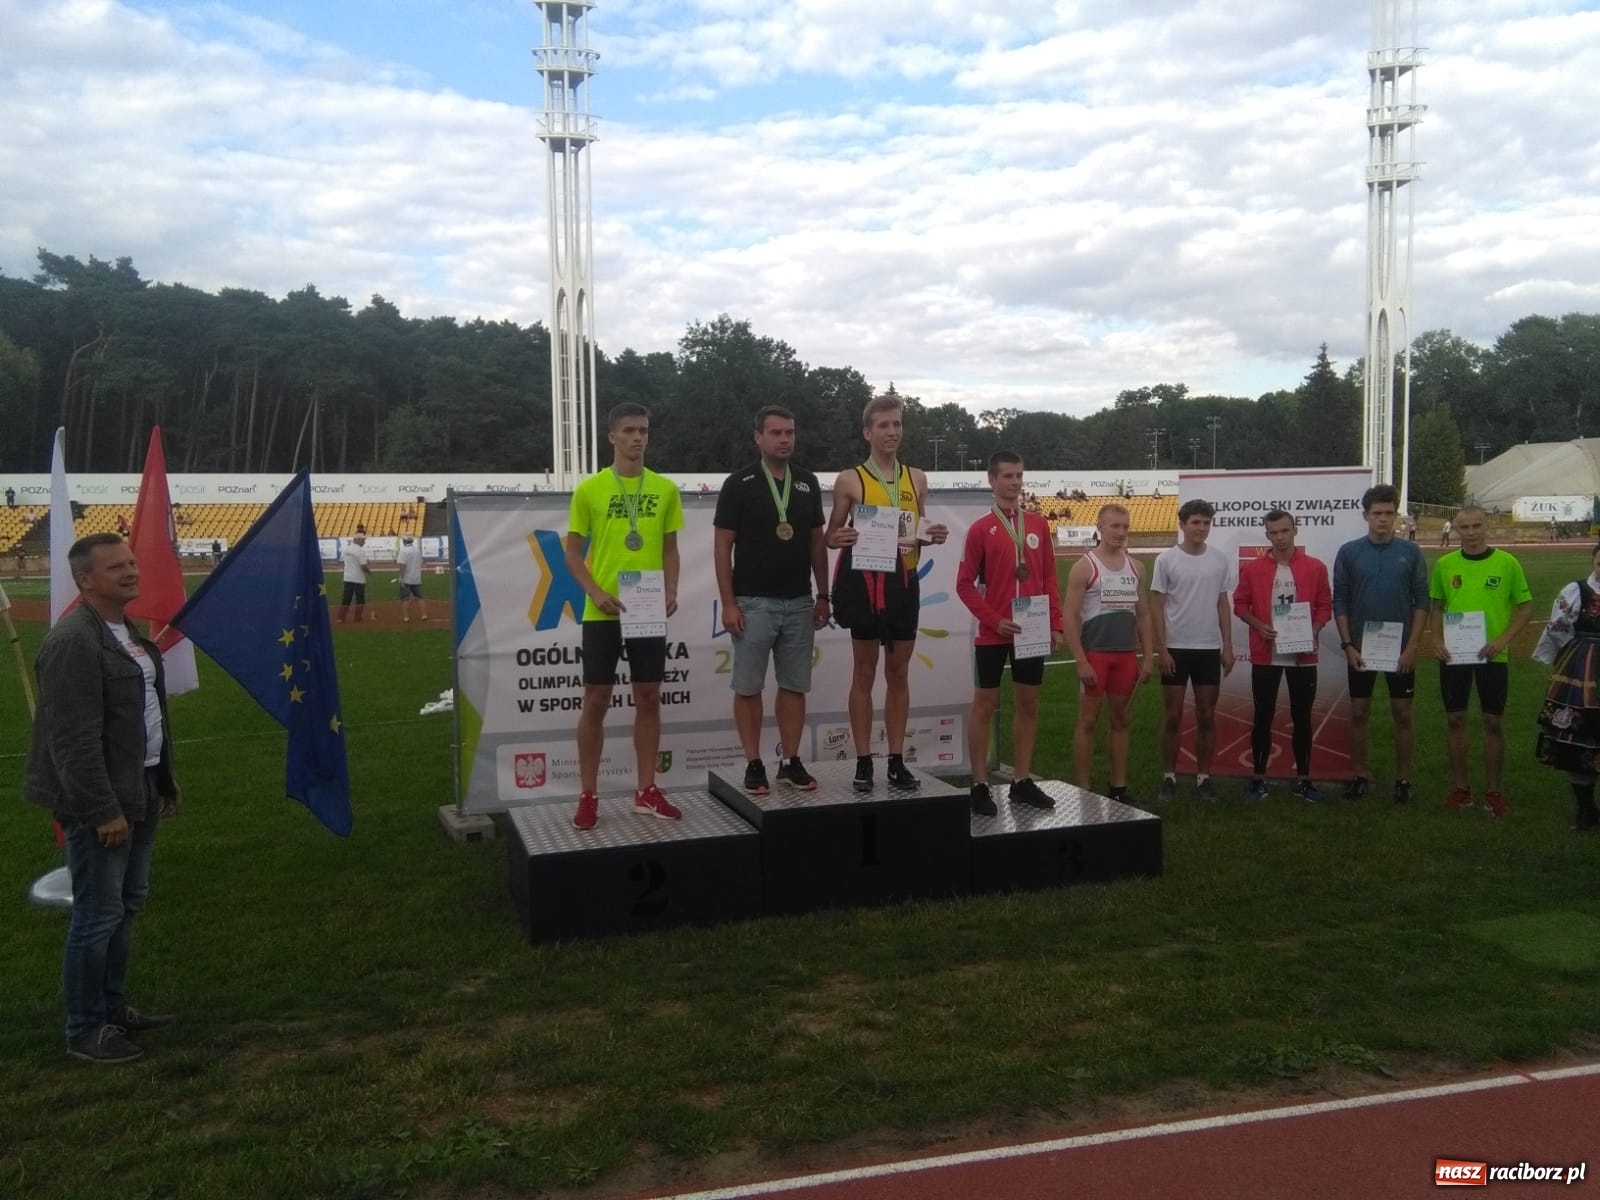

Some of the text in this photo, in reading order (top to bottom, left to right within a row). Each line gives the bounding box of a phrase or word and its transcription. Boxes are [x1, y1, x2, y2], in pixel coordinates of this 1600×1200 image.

[1295, 498, 1361, 513] ZWIĄZEK
[1212, 515, 1335, 528] LEKKIEJ ETYKI
[1120, 576, 1136, 585] 319
[517, 699, 535, 713] W
[627, 860, 670, 918] 2
